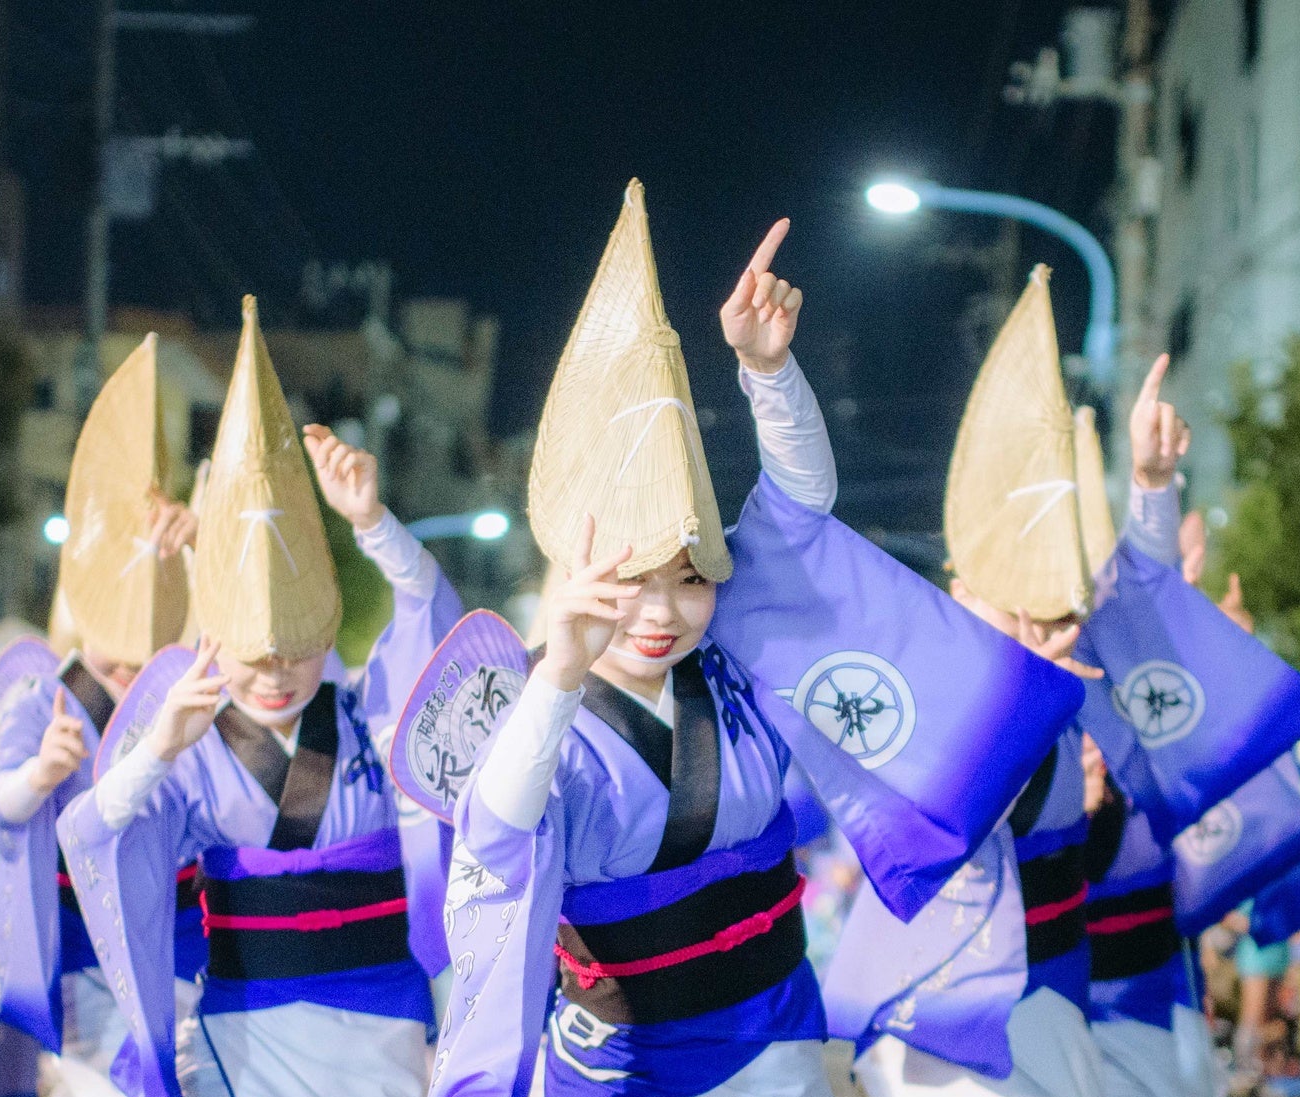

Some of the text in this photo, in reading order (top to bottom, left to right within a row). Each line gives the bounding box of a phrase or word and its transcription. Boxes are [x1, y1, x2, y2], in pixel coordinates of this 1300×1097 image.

[416, 660, 463, 740] 阿波おどり
